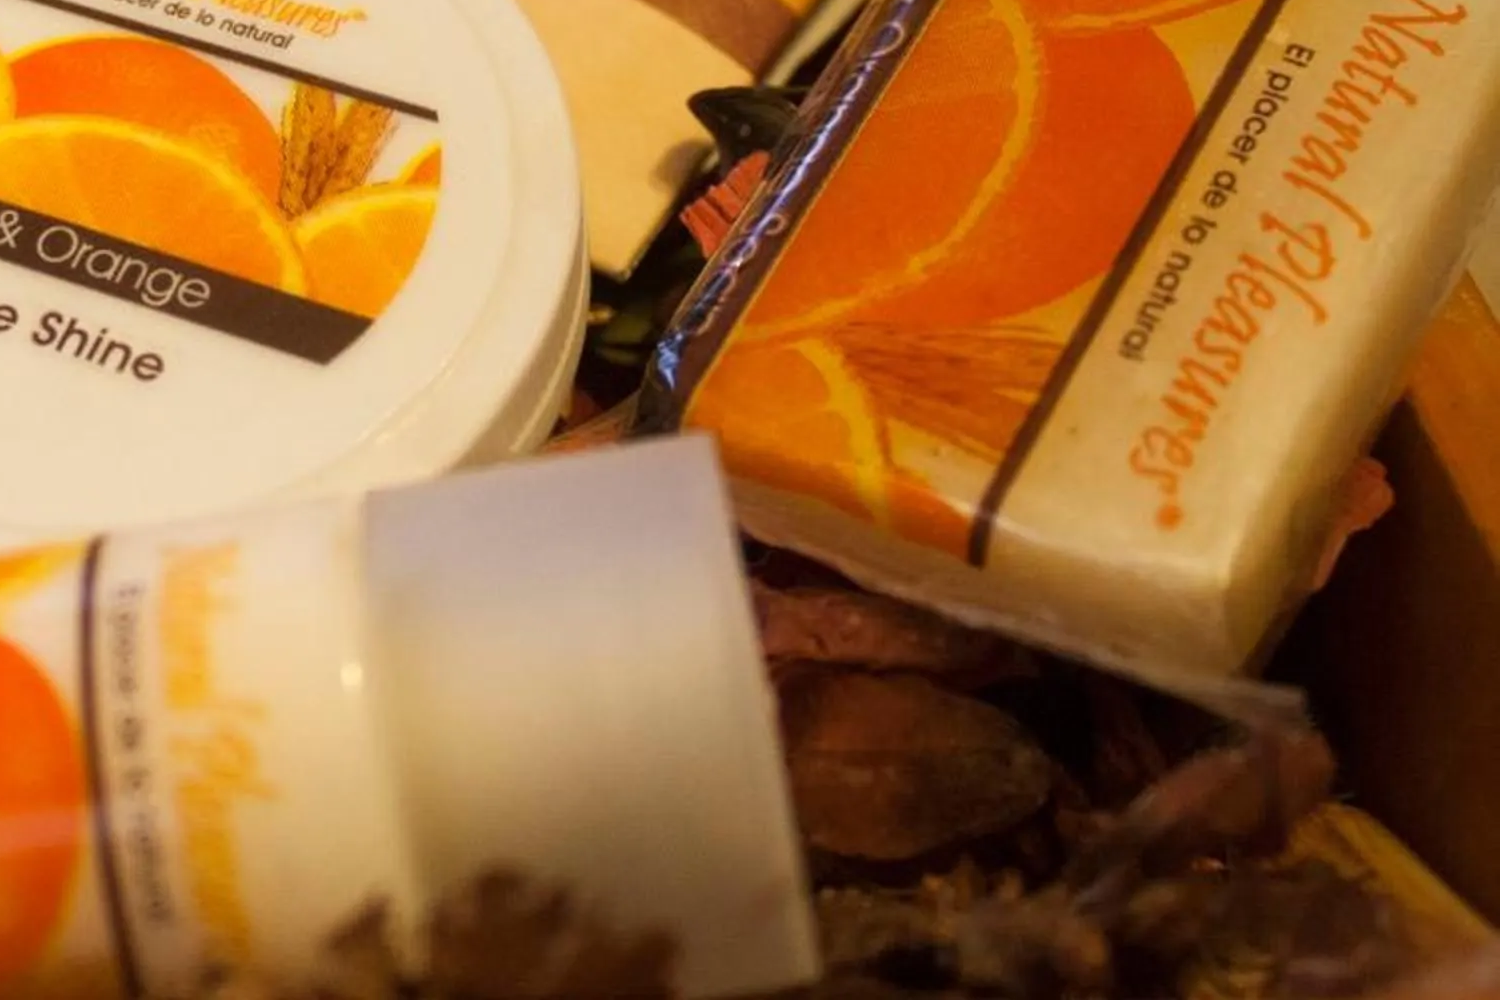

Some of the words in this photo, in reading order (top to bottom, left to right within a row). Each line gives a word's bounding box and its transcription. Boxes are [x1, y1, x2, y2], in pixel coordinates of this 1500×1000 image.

[163, 0, 193, 21] de
[218, 17, 296, 51] natural
[1283, 41, 1316, 69] El
[1233, 68, 1293, 168] placer
[1202, 168, 1239, 212] de
[36, 225, 212, 308] Orange
[1118, 249, 1193, 363] natural
[31, 310, 166, 383] Shine
[1128, 210, 1338, 500] Pleasures
